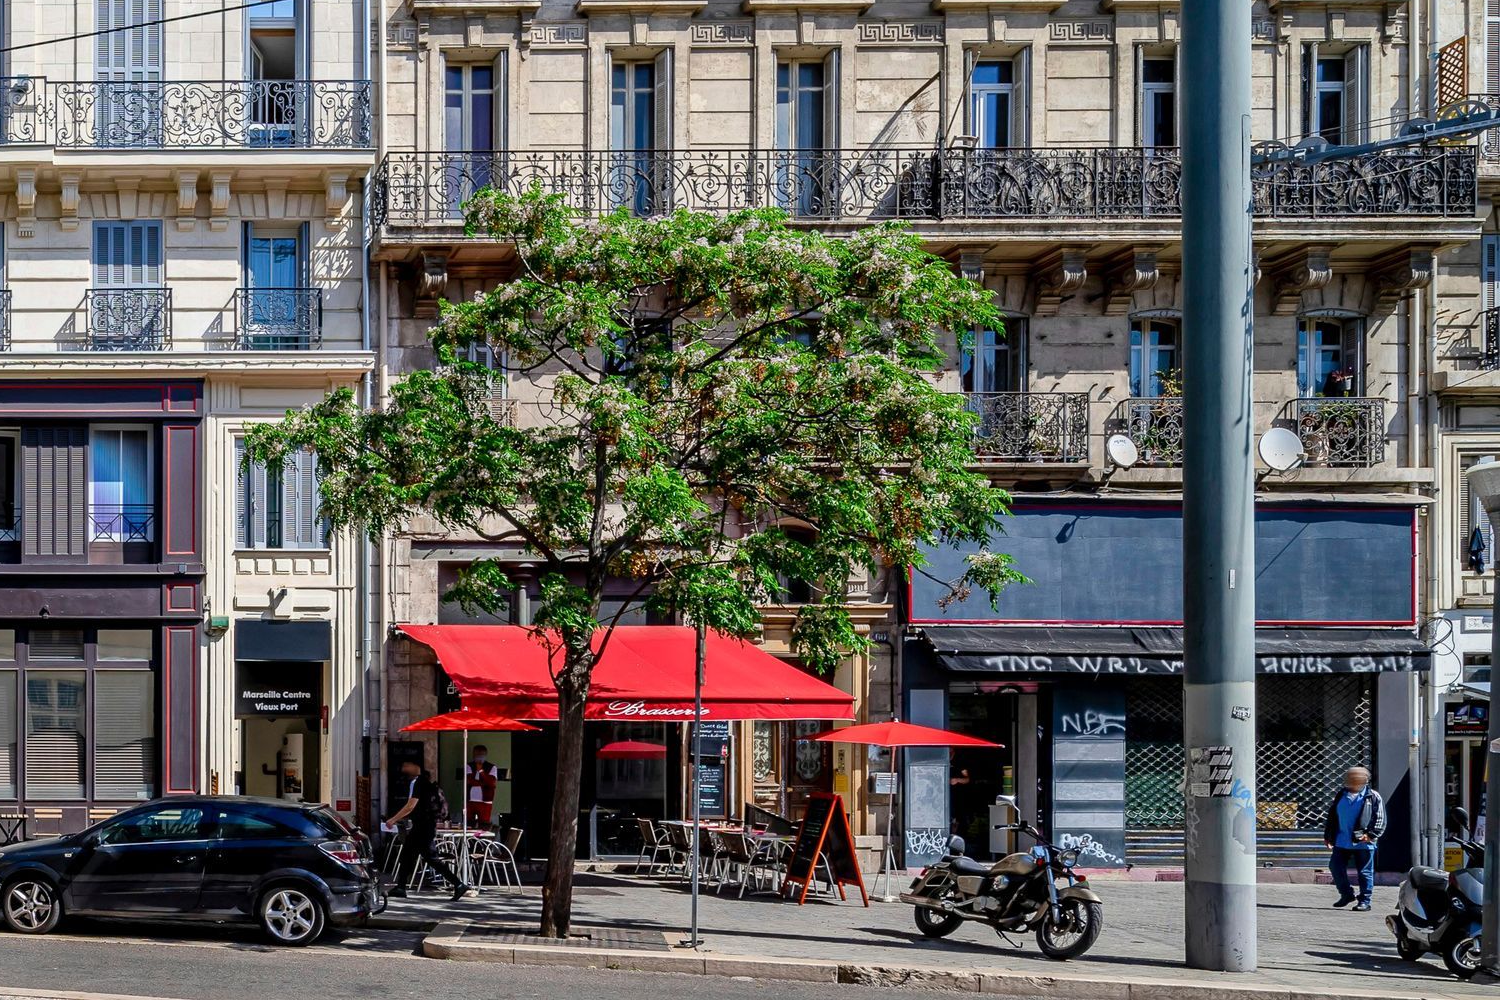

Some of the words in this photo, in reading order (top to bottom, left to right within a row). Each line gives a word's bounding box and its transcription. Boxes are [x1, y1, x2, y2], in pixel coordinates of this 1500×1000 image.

[242, 690, 282, 699] Marseille
[282, 691, 311, 699] Centre
[255, 702, 279, 711] Vieux
[280, 703, 299, 711] Port
